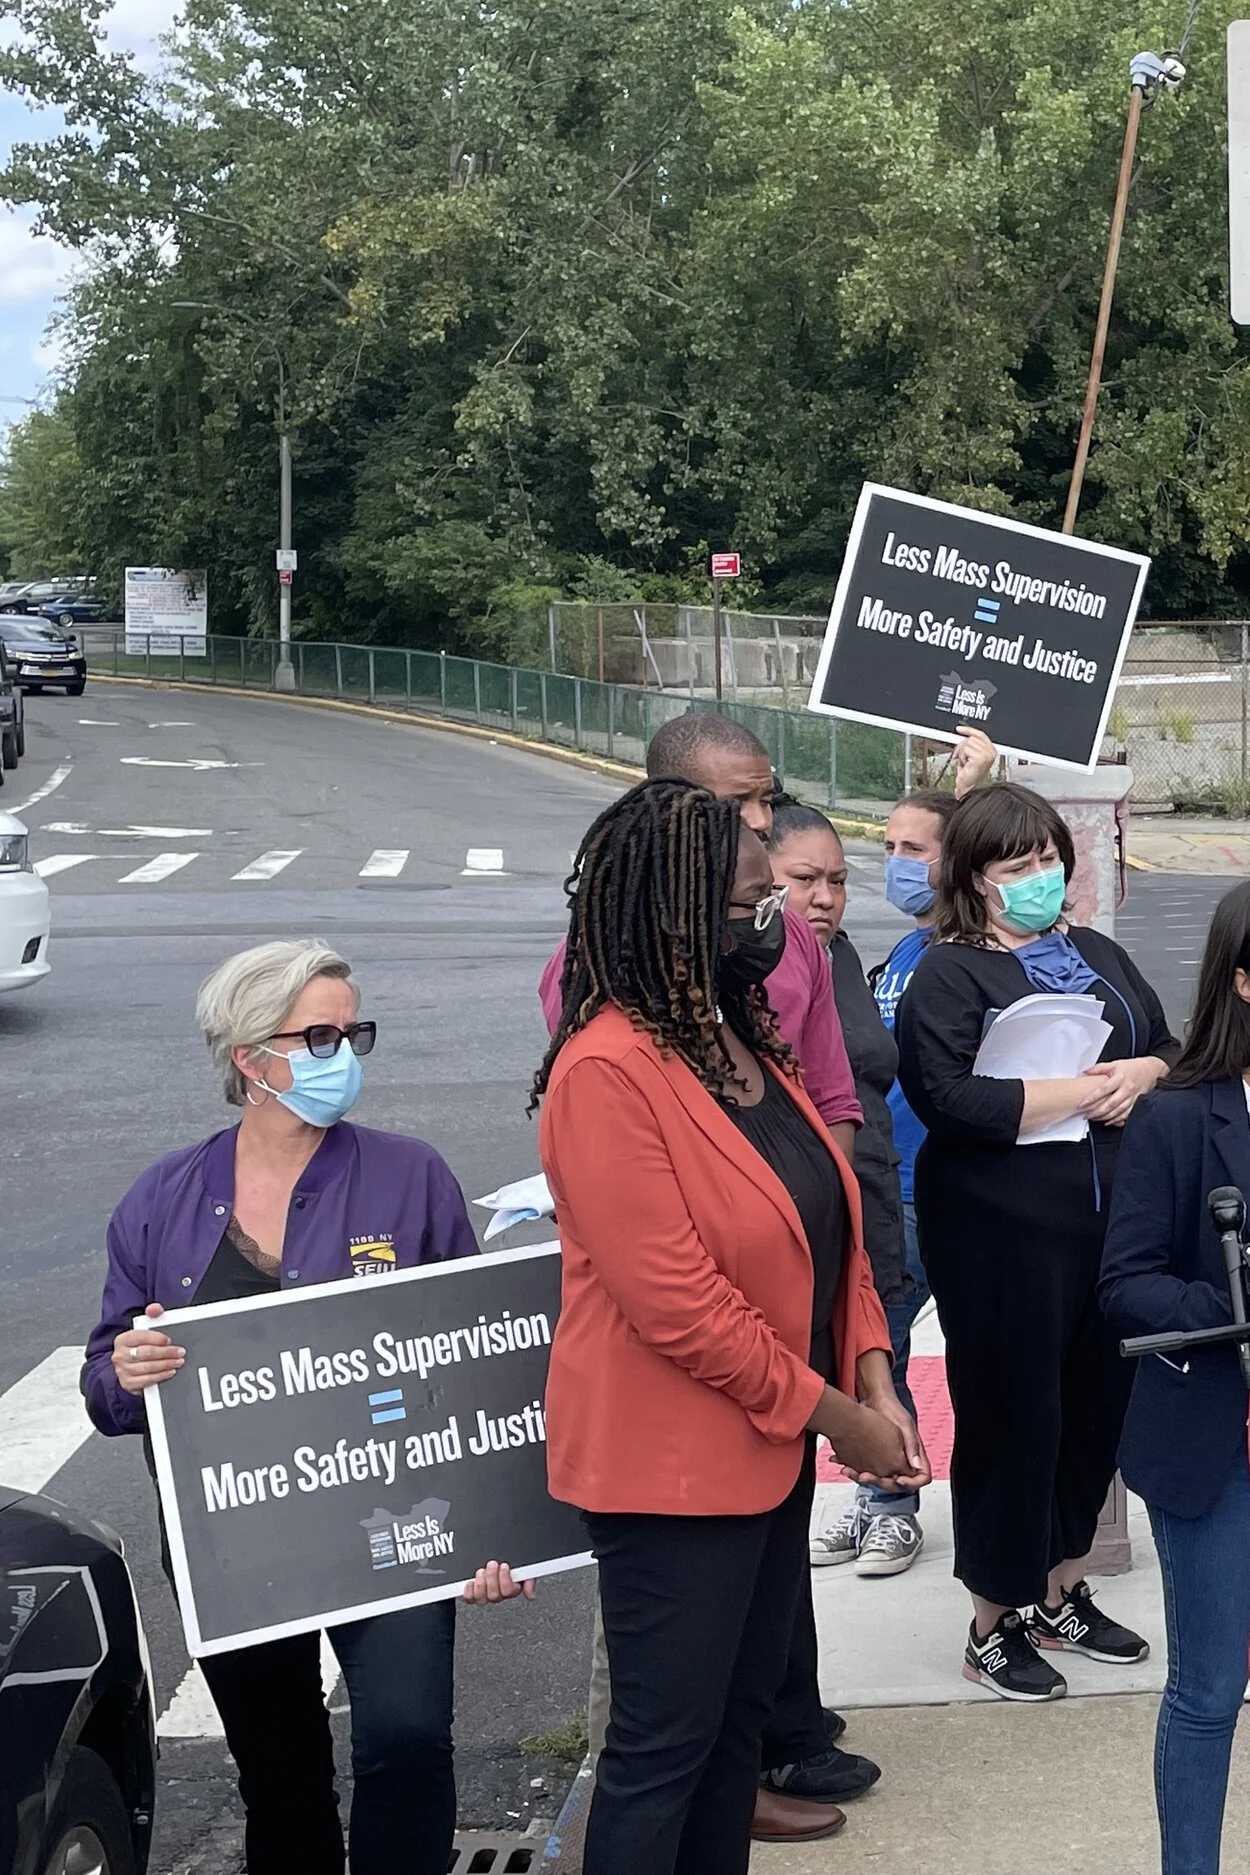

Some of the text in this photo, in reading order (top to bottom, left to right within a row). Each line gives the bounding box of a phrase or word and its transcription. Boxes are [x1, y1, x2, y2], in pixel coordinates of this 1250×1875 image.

[882, 532, 1107, 620] Less Mass Supervision
[857, 595, 1098, 684] More Safety and Justice
[951, 698, 975, 718] More
[975, 704, 992, 721] NY
[955, 684, 976, 703] Less
[976, 689, 985, 705] Is
[379, 1233, 393, 1241] NY
[198, 1310, 552, 1412] Less Mass Supervision
[201, 1400, 547, 1513] More Safety and Justi
[393, 1514, 440, 1543] Less Is
[396, 1541, 434, 1565] More
[433, 1531, 454, 1556] NY
